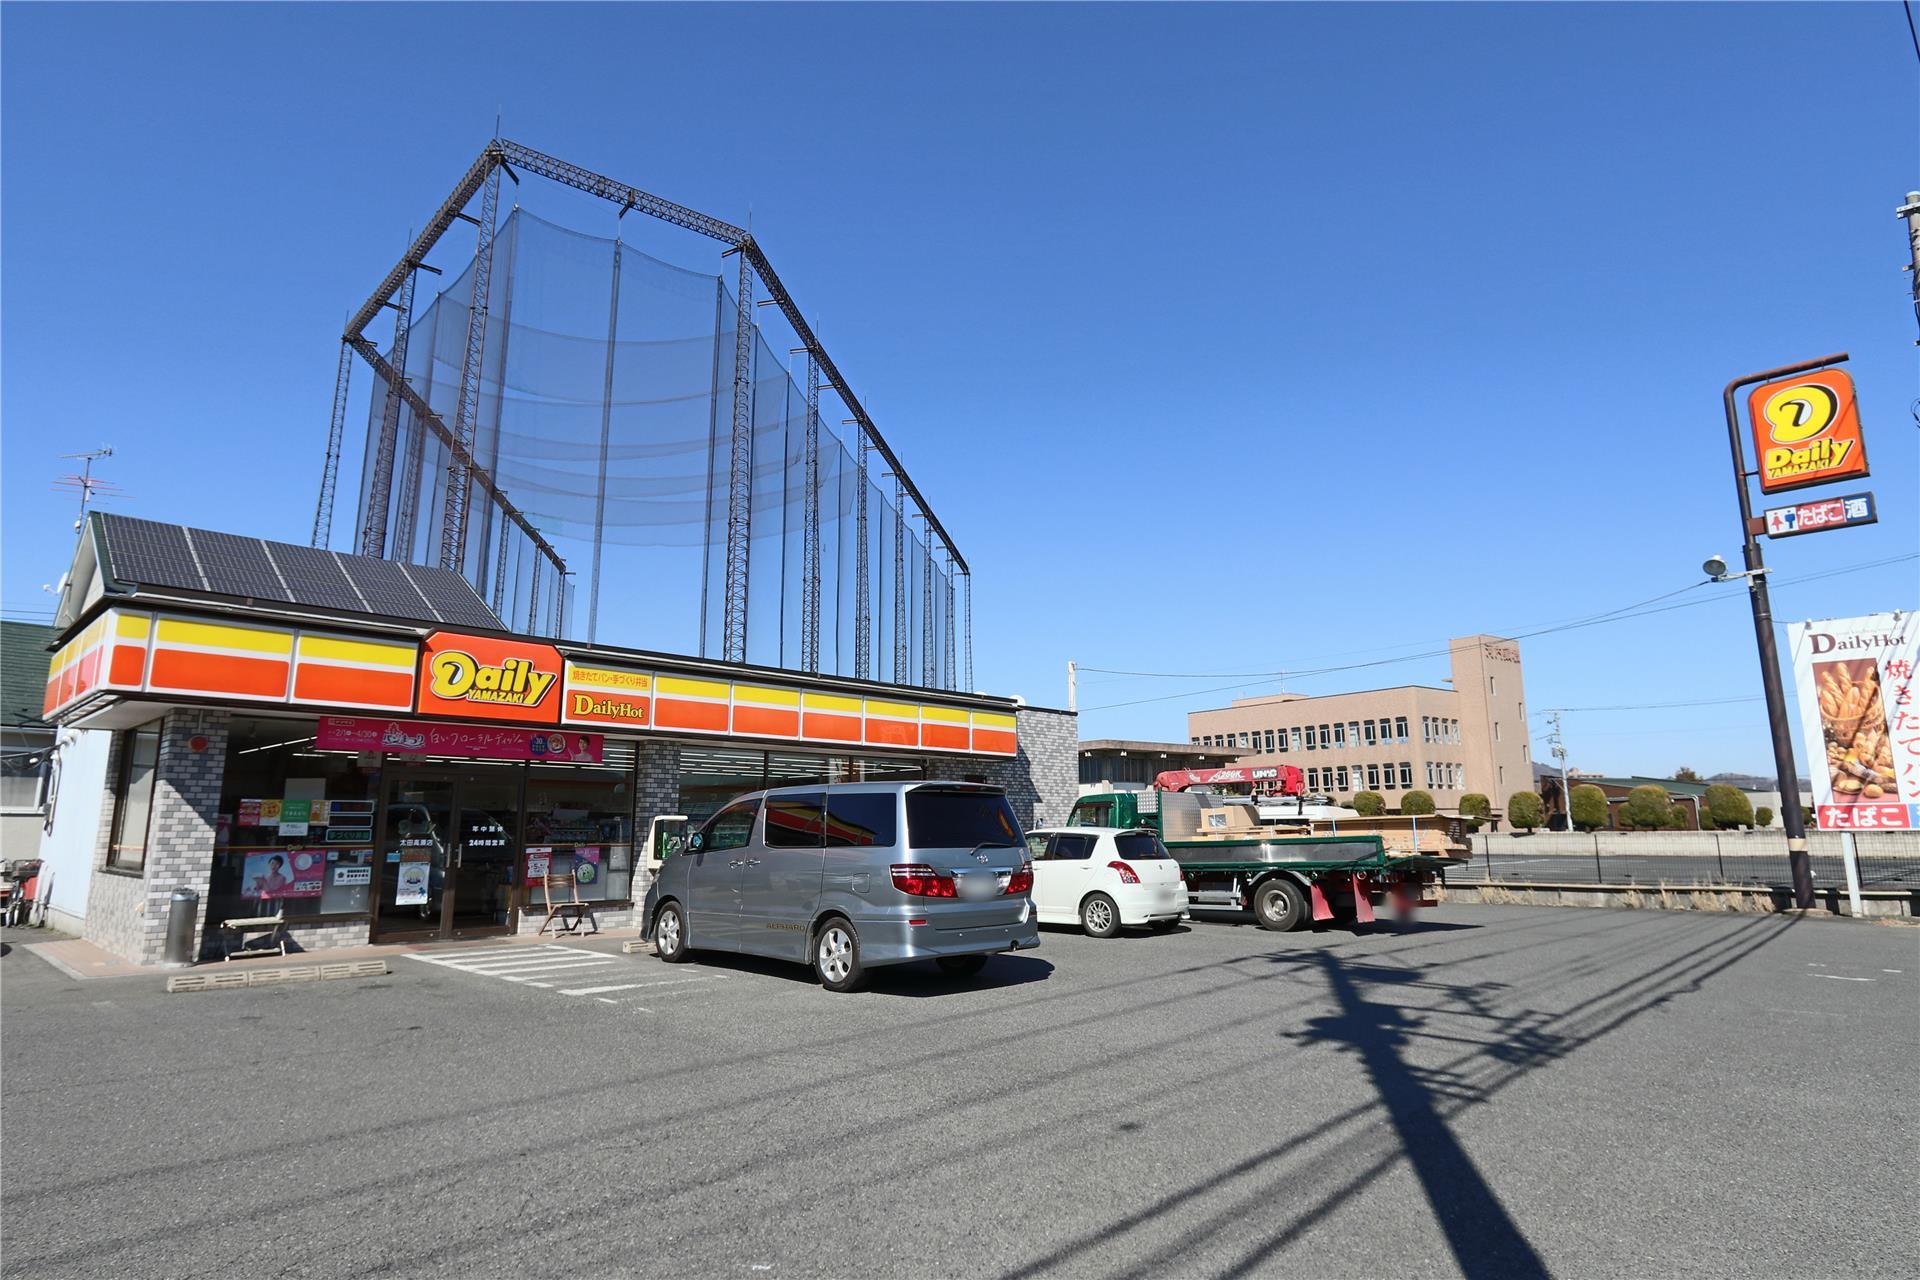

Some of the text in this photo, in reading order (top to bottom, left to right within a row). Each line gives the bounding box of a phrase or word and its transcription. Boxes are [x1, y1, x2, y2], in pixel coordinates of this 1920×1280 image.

[1767, 438, 1853, 470] Daily
[1767, 459, 1830, 478] YAMAZAKI
[1797, 498, 1869, 526] たばこ 酒
[432, 650, 557, 704] Daily
[468, 690, 524, 704] YAMAZAKI
[1825, 806, 1904, 828] たばこ
